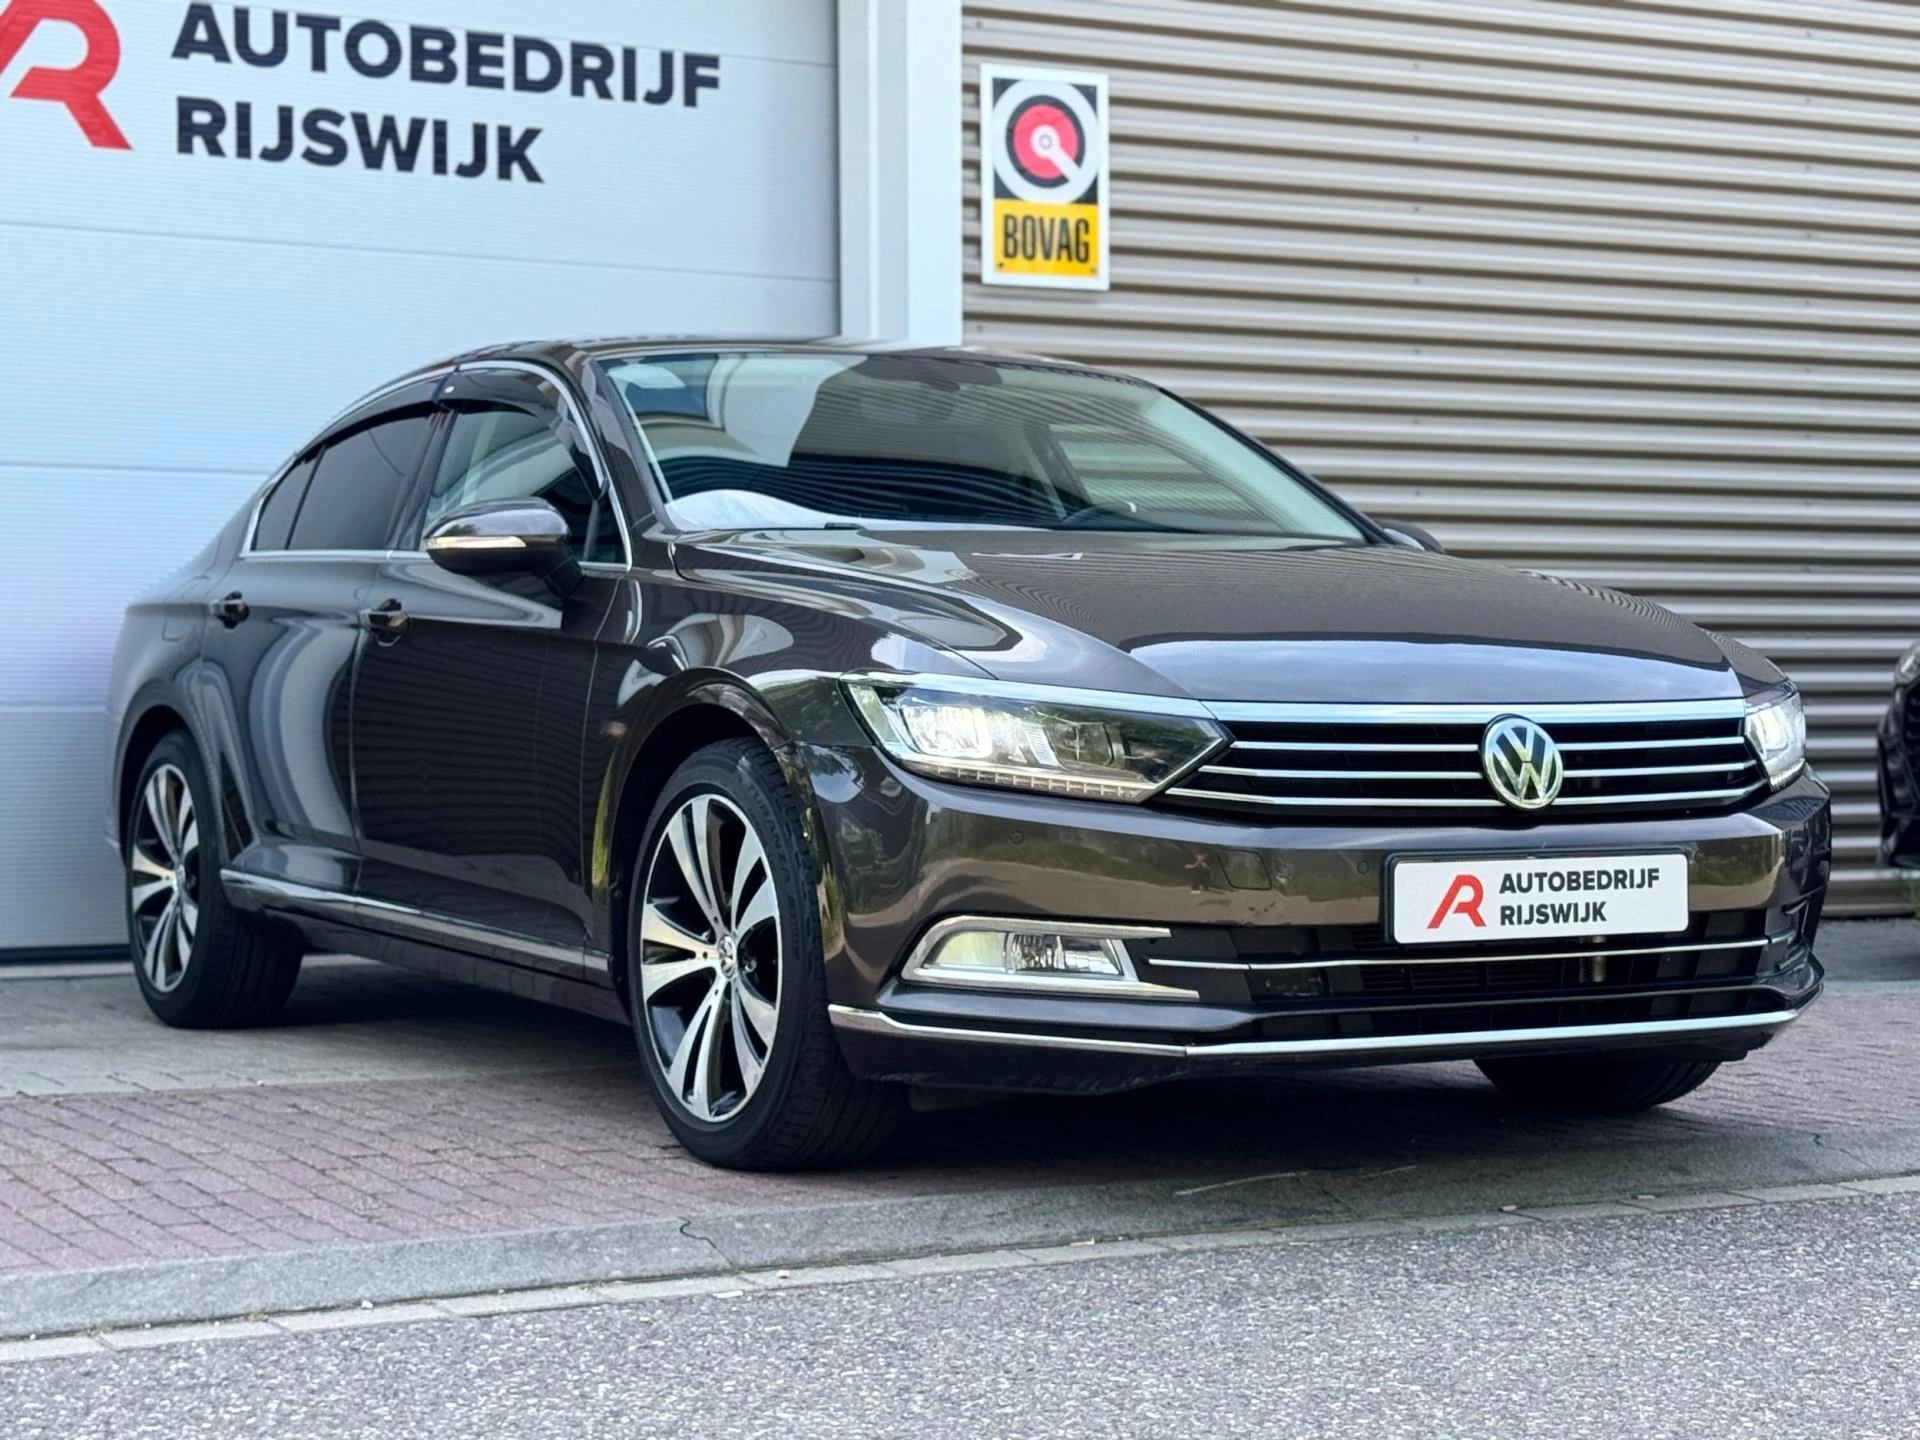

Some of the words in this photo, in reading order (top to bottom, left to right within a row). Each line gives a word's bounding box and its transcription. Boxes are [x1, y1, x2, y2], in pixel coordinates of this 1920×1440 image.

[171, 2, 720, 108] AUTOBEDRIJF
[176, 96, 545, 183] RIJSWIJK
[1003, 214, 1090, 264] BOVAG
[1499, 867, 1660, 894] AUTOBEDRIJF
[1500, 901, 1607, 926] RIJSWIJK
